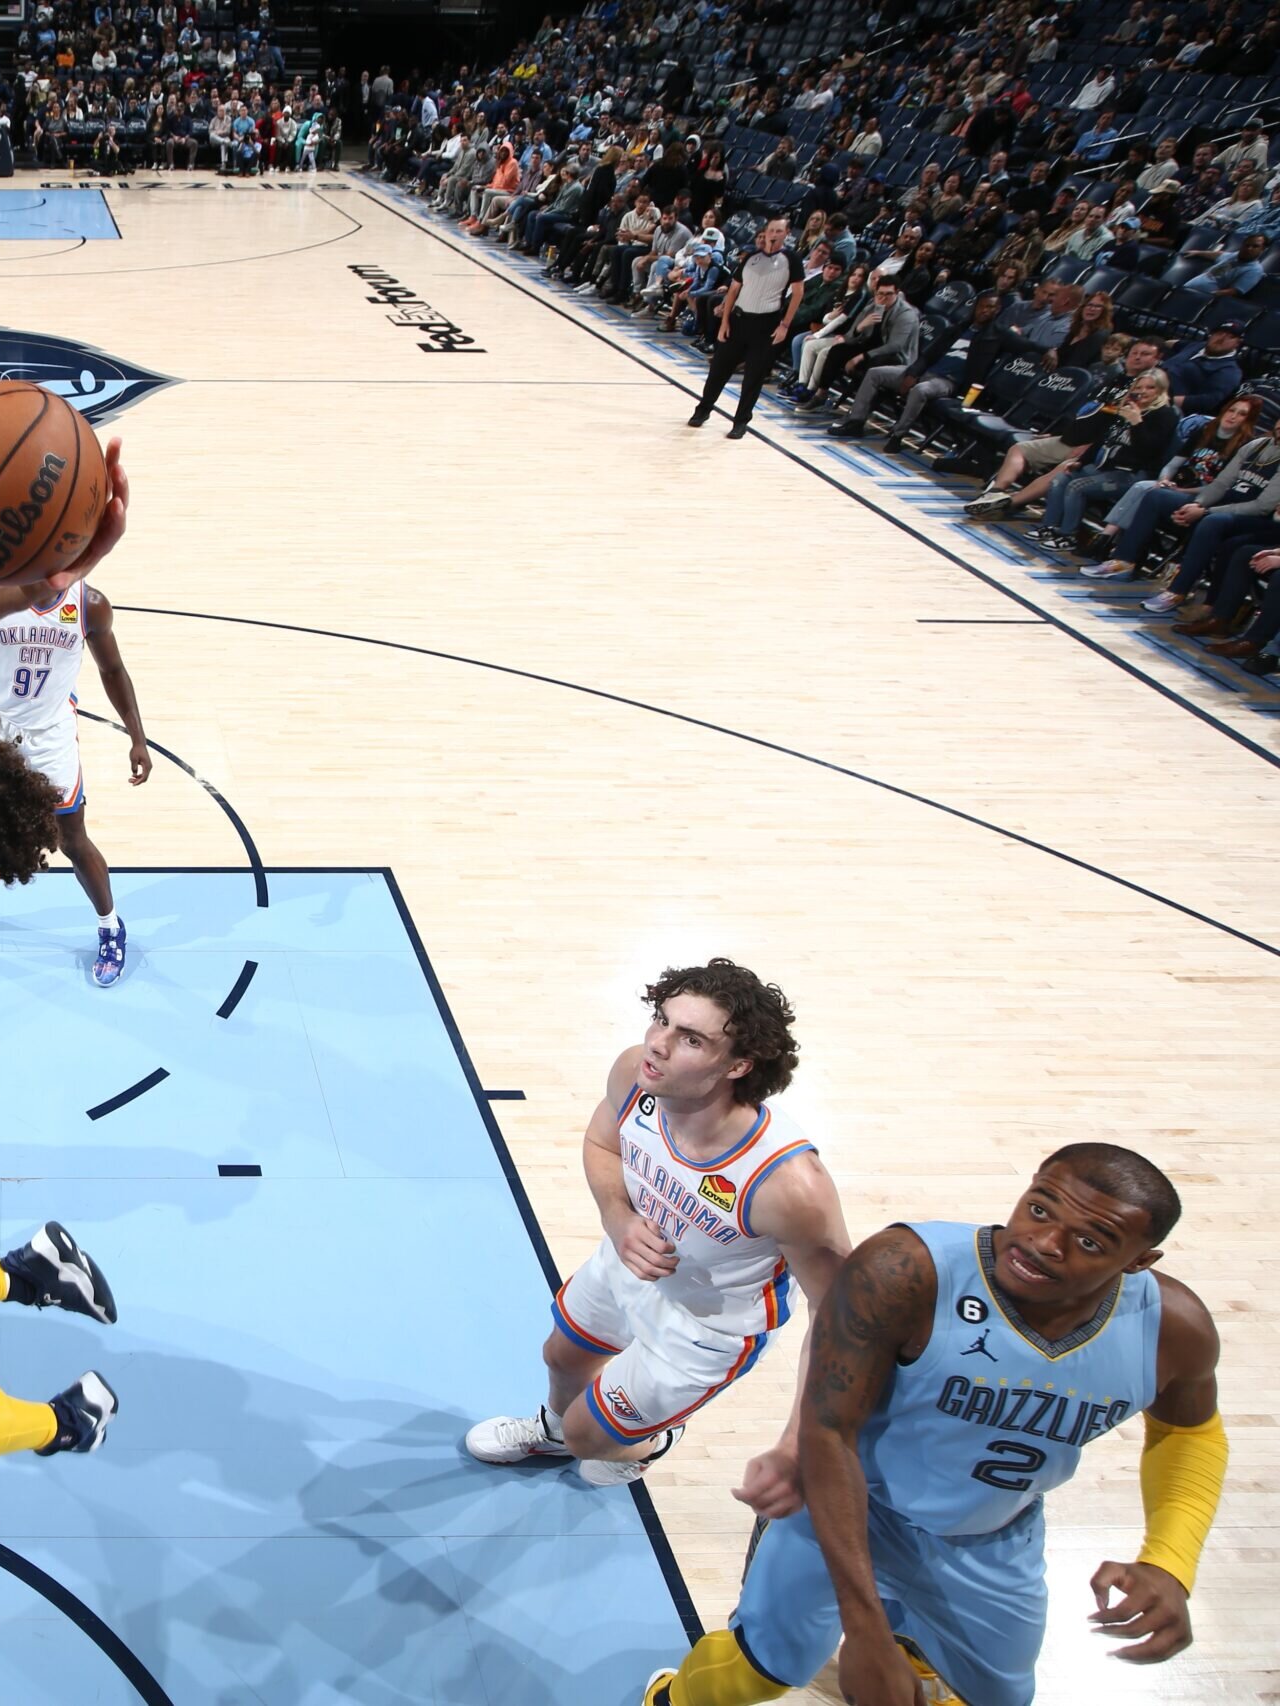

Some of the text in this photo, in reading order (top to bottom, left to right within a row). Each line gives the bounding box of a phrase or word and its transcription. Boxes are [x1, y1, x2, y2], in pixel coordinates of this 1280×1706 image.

[40, 182, 352, 190] GRIZZLIES
[347, 265, 488, 353] FedExForum
[19, 646, 54, 665] CITY
[12, 667, 52, 699] 97
[641, 1095, 655, 1114] 6
[620, 1134, 741, 1246] OKLAHOMA
[701, 1184, 732, 1209] Love's
[637, 1185, 690, 1242] CITY
[963, 1299, 981, 1320] 6
[974, 1376, 1112, 1404] MEMPHIS
[936, 1375, 1130, 1447] GRIZZLIES
[971, 1440, 1047, 1492] 2
